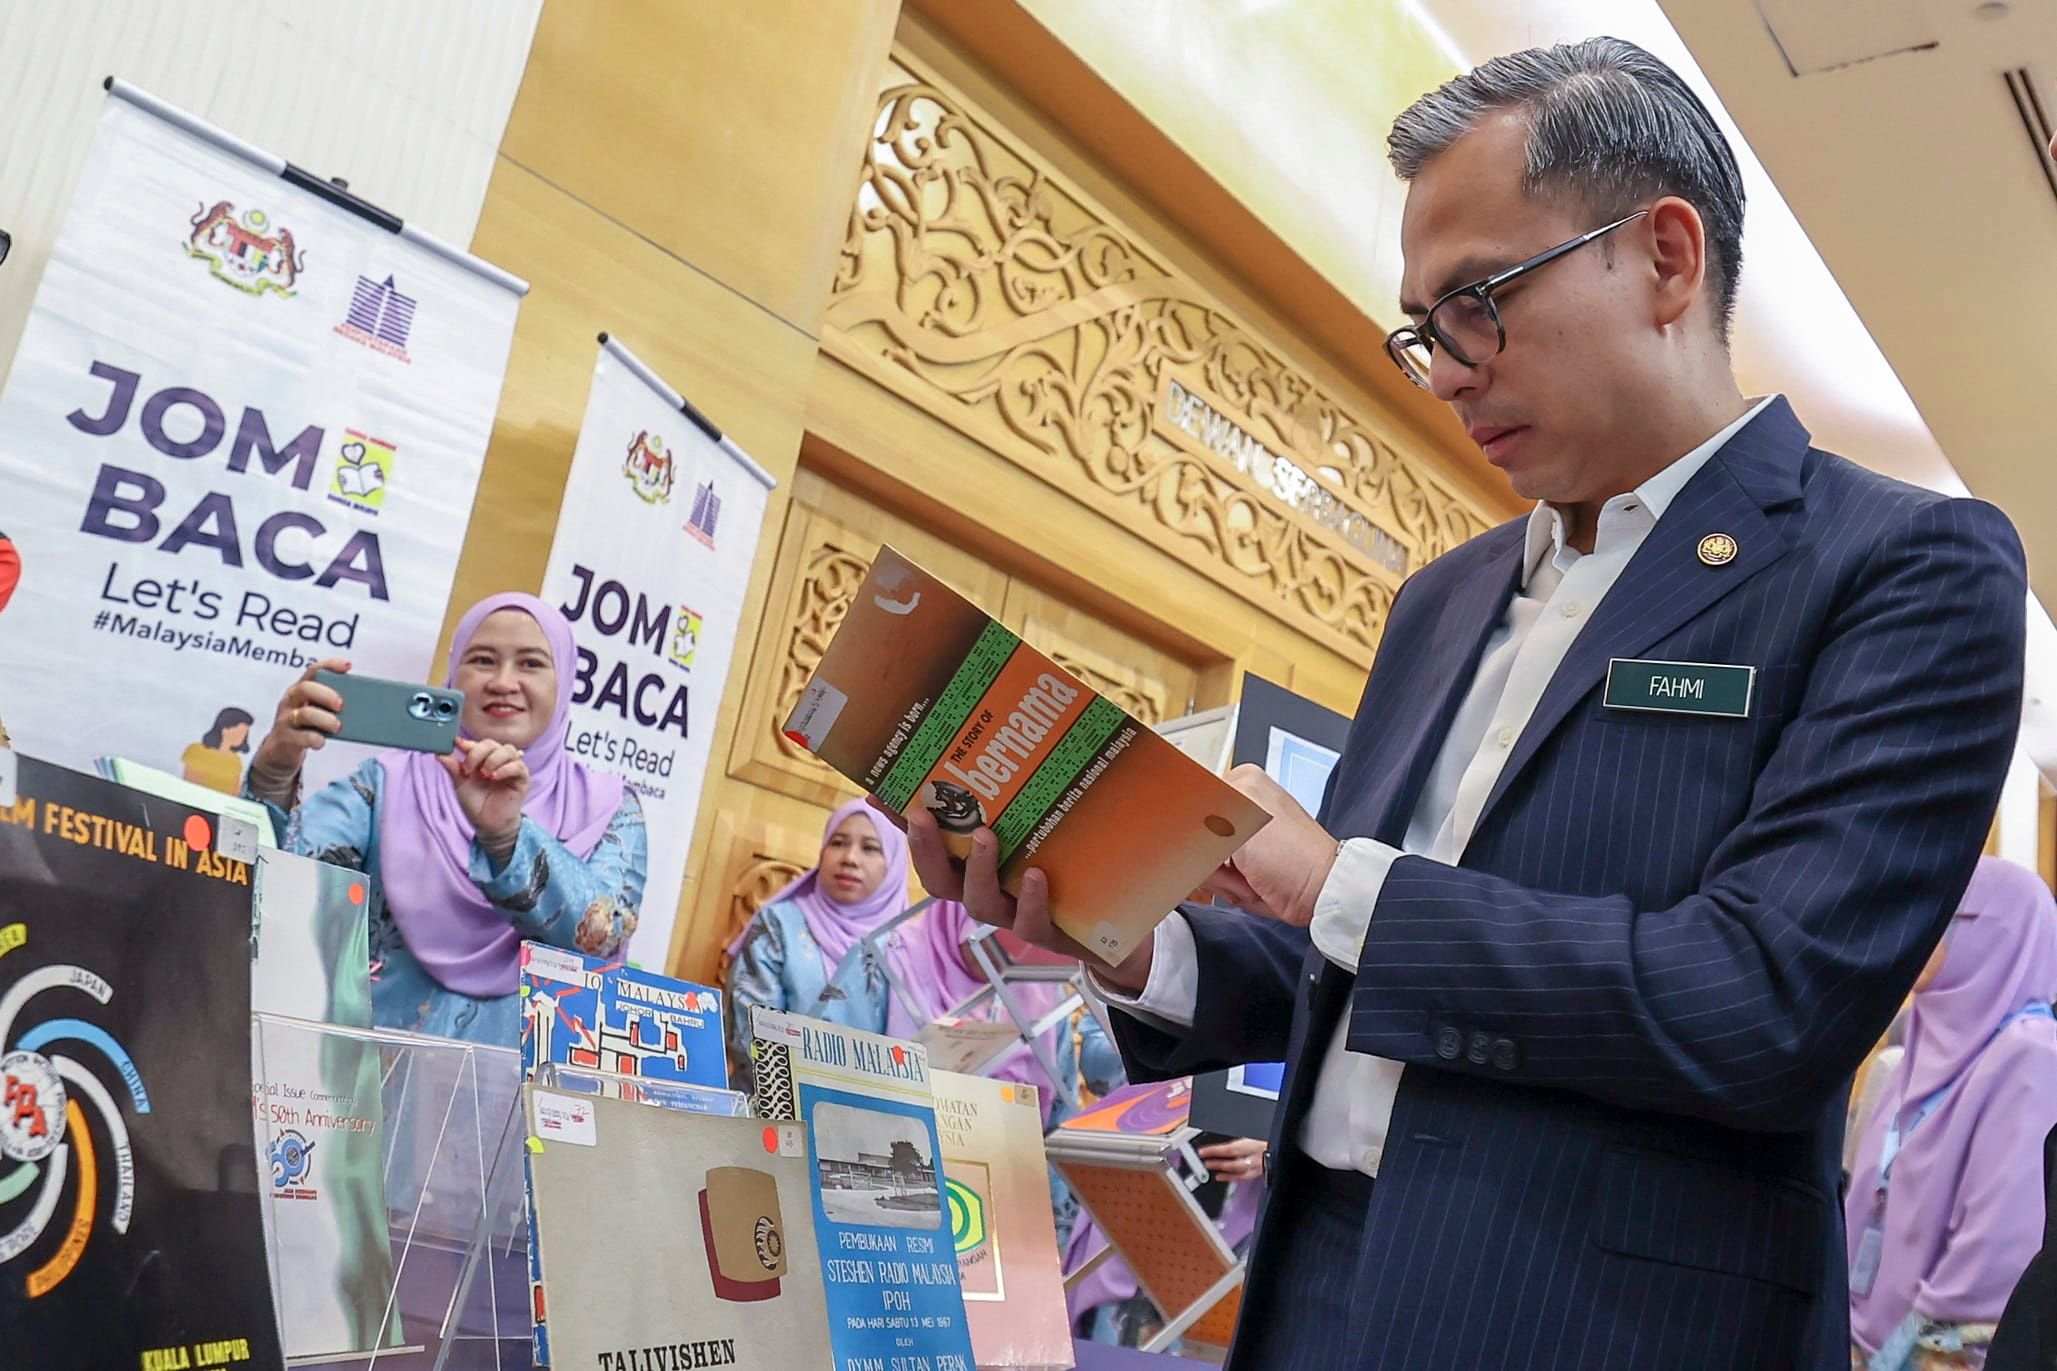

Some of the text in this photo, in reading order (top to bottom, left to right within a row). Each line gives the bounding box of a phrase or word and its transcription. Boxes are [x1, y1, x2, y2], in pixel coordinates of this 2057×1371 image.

[66, 360, 325, 490] JOM
[79, 463, 389, 602] BACA
[101, 562, 360, 649] Let's Read
[559, 563, 672, 656] JOM
[93, 610, 317, 670] #MalaysiaMemba
[570, 646, 688, 739] BACA
[1649, 675, 1704, 699] FAHMI
[563, 721, 676, 777] Let's Read
[870, 756, 889, 778] news
[883, 729, 908, 757] agency
[898, 721, 912, 732] is
[943, 673, 1079, 801] bernama
[951, 709, 994, 763] THE STORY OF
[1057, 787, 1083, 812] berita
[1079, 756, 1109, 789] nasional
[1105, 727, 1137, 760] malaysia
[44, 803, 158, 862] FESTIVAL
[165, 836, 188, 869] IN
[196, 848, 248, 885] ASIA
[70, 969, 109, 997] JAPAN
[619, 1004, 704, 1028] JOHOR BAHRU
[802, 1026, 847, 1067] RADIO
[122, 1060, 146, 1109] CHINA
[283, 1083, 306, 1099] Issue
[270, 1104, 300, 1124] 50th
[304, 1108, 376, 1136] Anniversary
[117, 1142, 134, 1222] THAILAND
[838, 1231, 934, 1254] PEMBUKAAN RESMI
[827, 1259, 875, 1284] STESHEN
[879, 1262, 909, 1285] RADIO
[911, 1263, 956, 1286] MALAYSIA
[847, 1317, 867, 1329] PADA
[867, 1316, 885, 1329] HARI
[885, 1316, 909, 1329] SABTU
[910, 1316, 919, 1328] 13
[921, 1317, 935, 1329] MEI
[882, 1290, 912, 1311] IPOH
[141, 1338, 250, 1371] KUALA LUMPUR
[598, 1338, 736, 1371] TALIVISHEN
[890, 1356, 930, 1371] SULTAN
[936, 1354, 967, 1371] PERAK
[895, 1337, 914, 1347] OLEH
